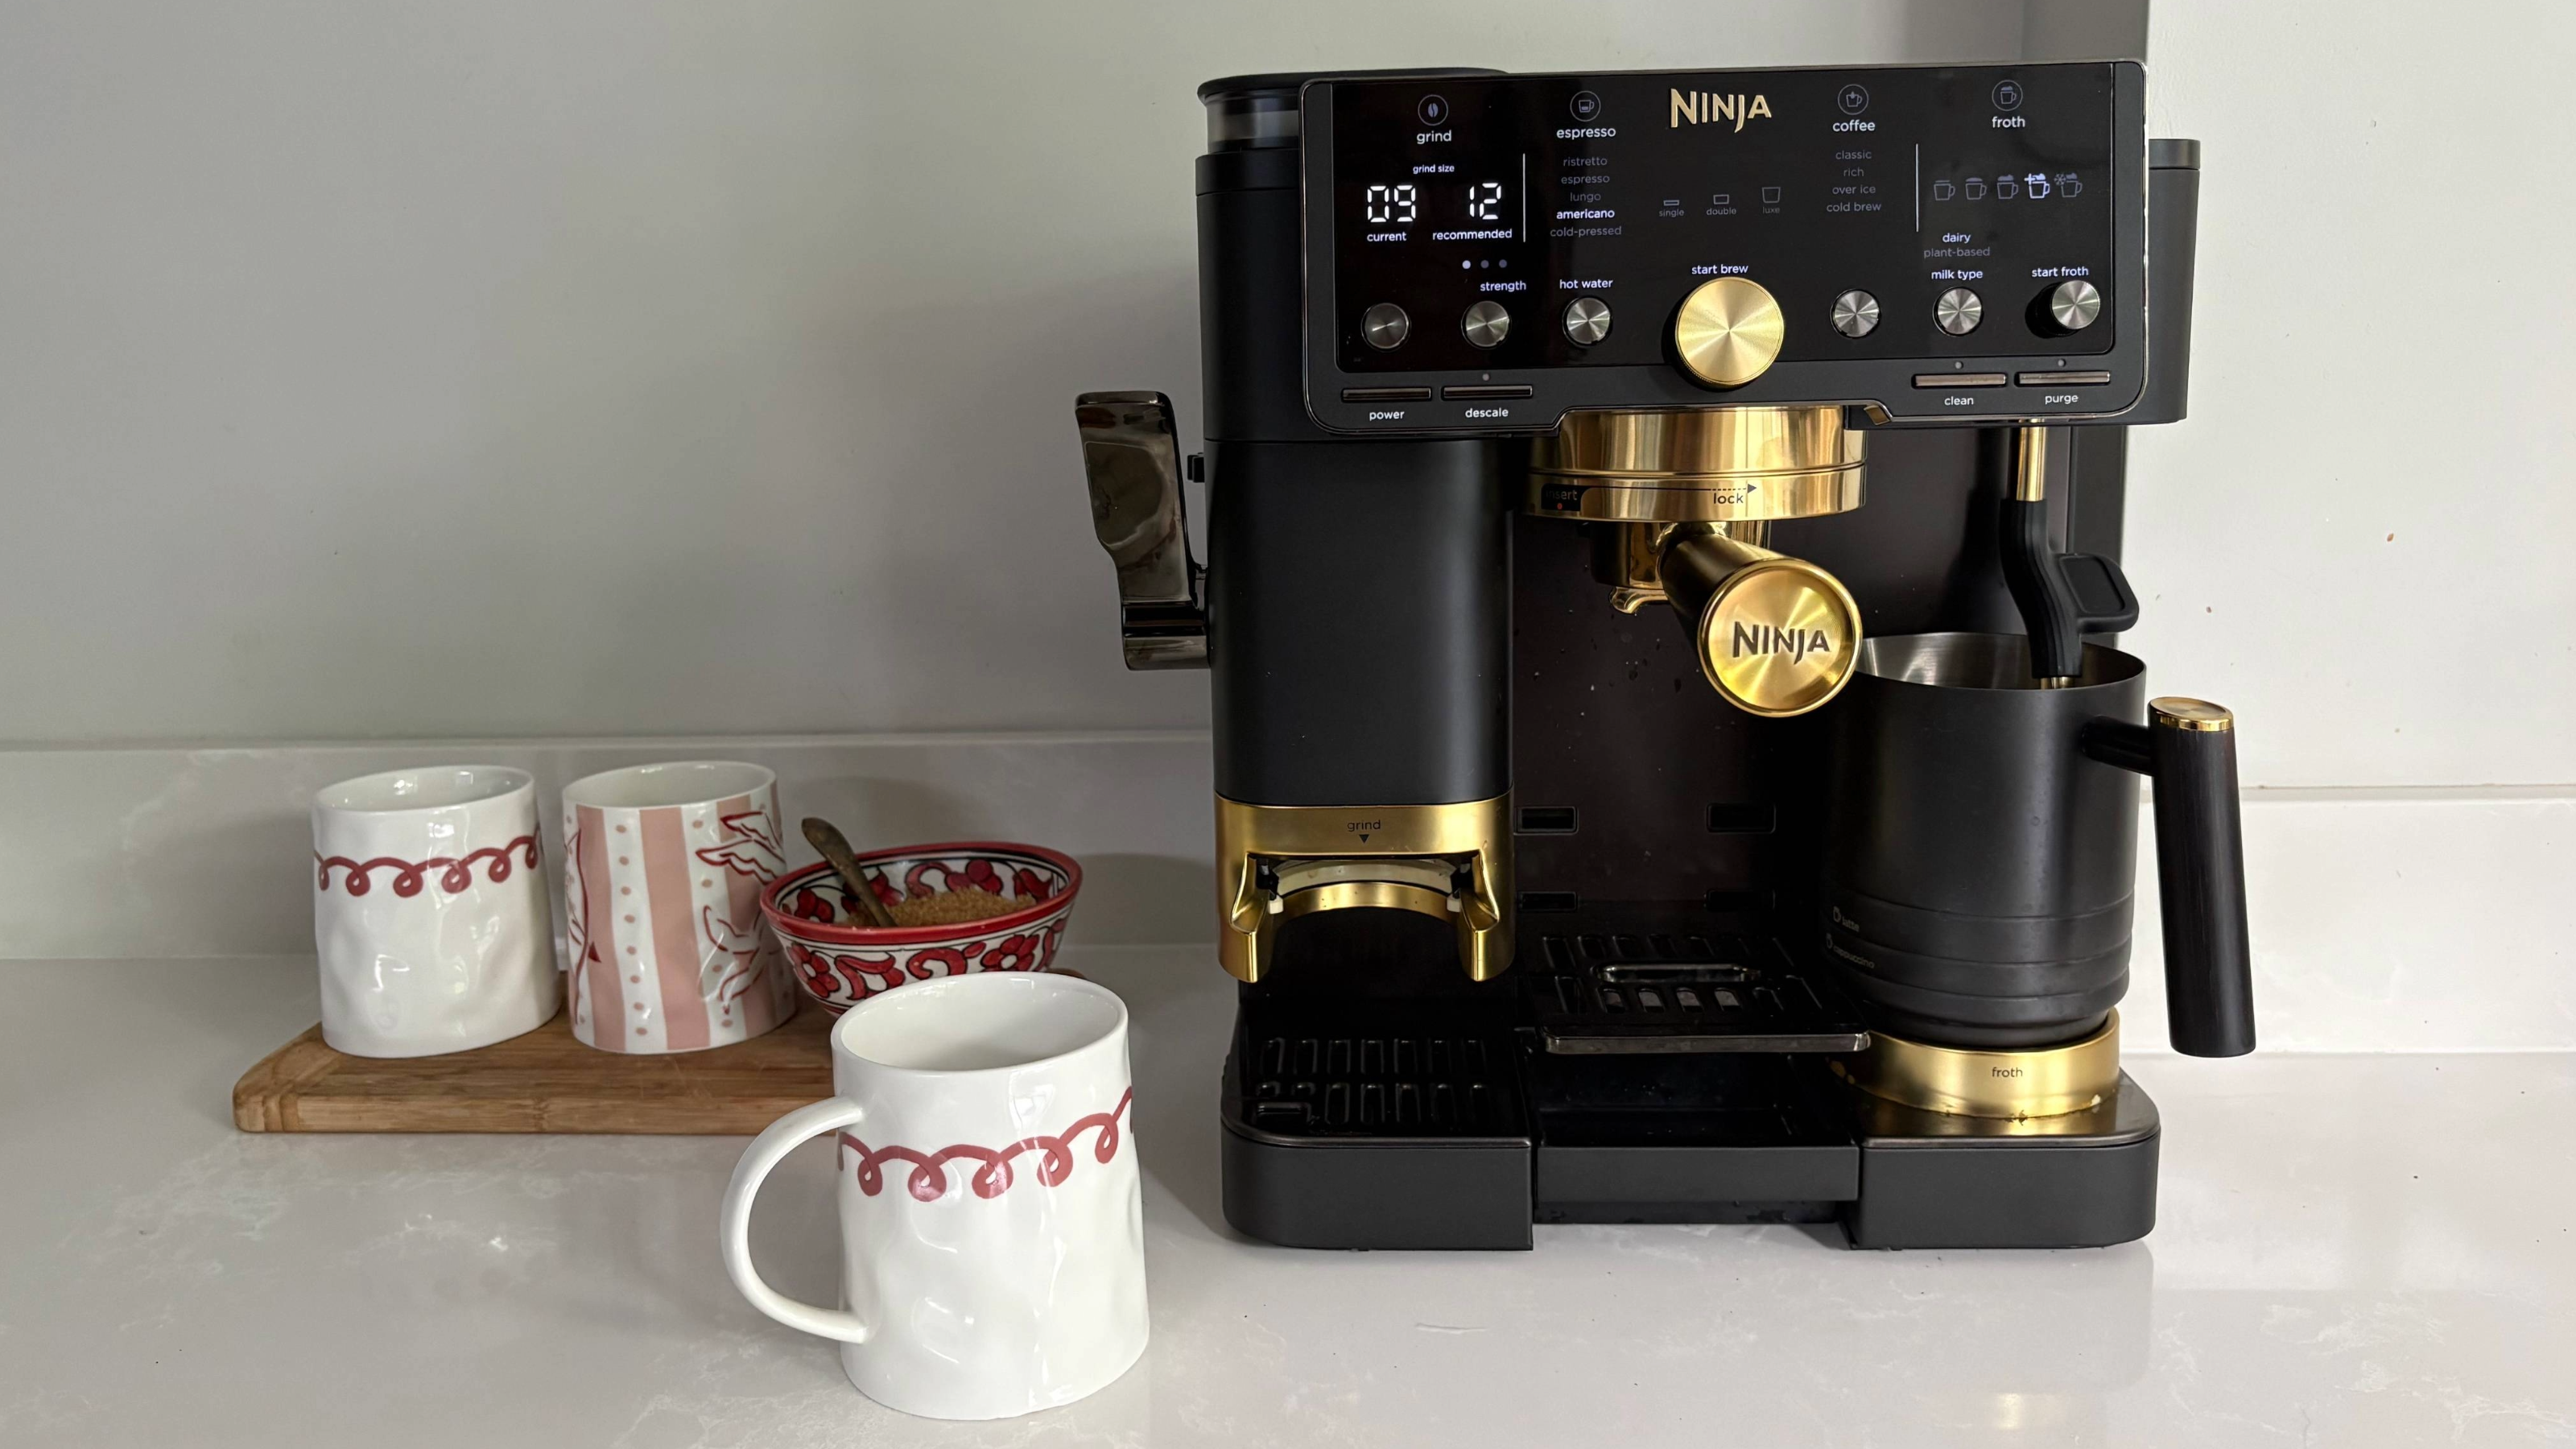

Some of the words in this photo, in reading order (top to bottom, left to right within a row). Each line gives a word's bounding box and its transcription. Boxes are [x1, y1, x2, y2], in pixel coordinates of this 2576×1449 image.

[1670, 88, 1773, 134] NINJA
[1832, 118, 1876, 132] coffee
[1992, 115, 2026, 128] froth
[1416, 129, 1452, 145] grind
[1556, 127, 1616, 140] espresso
[1835, 149, 1872, 160] classic
[1563, 156, 1608, 167] ristretto
[1412, 163, 1435, 175] grind
[1438, 163, 1455, 172] size
[1843, 167, 1864, 177] rich
[1561, 175, 1611, 186] espresso
[1831, 186, 1857, 195] over
[1860, 184, 1876, 194] ice
[1367, 184, 1417, 223] 09
[1469, 182, 1502, 221] 12
[1570, 192, 1602, 204] lungo
[1658, 207, 1686, 218] single
[1706, 206, 1737, 216] double
[1762, 204, 1781, 215] luxe
[1826, 201, 1851, 213] cold
[1853, 201, 1882, 212] brew
[1556, 208, 1616, 220] americano
[1366, 231, 1407, 242] current
[1432, 228, 1513, 241] recommended
[1550, 225, 1622, 238] cold-pressed
[1942, 232, 1971, 244] dairy
[1923, 246, 1991, 259] plant-based
[1691, 264, 1718, 275] start
[1720, 263, 1749, 275] brew
[1931, 269, 1955, 279] milk
[1957, 269, 1984, 281] type
[2031, 266, 2058, 278] start
[2061, 266, 2089, 277] froth
[1480, 280, 1527, 293] strength
[1559, 279, 1579, 289] hot
[1581, 279, 1613, 289] water
[1944, 395, 1975, 406] clean
[2045, 394, 2079, 405] purge
[1368, 411, 1405, 422] power
[1464, 407, 1509, 419] descale
[1713, 492, 1744, 505] lock
[1733, 621, 1831, 665] NINJA
[1347, 819, 1381, 832] grind
[1992, 1066, 2023, 1078] froth
